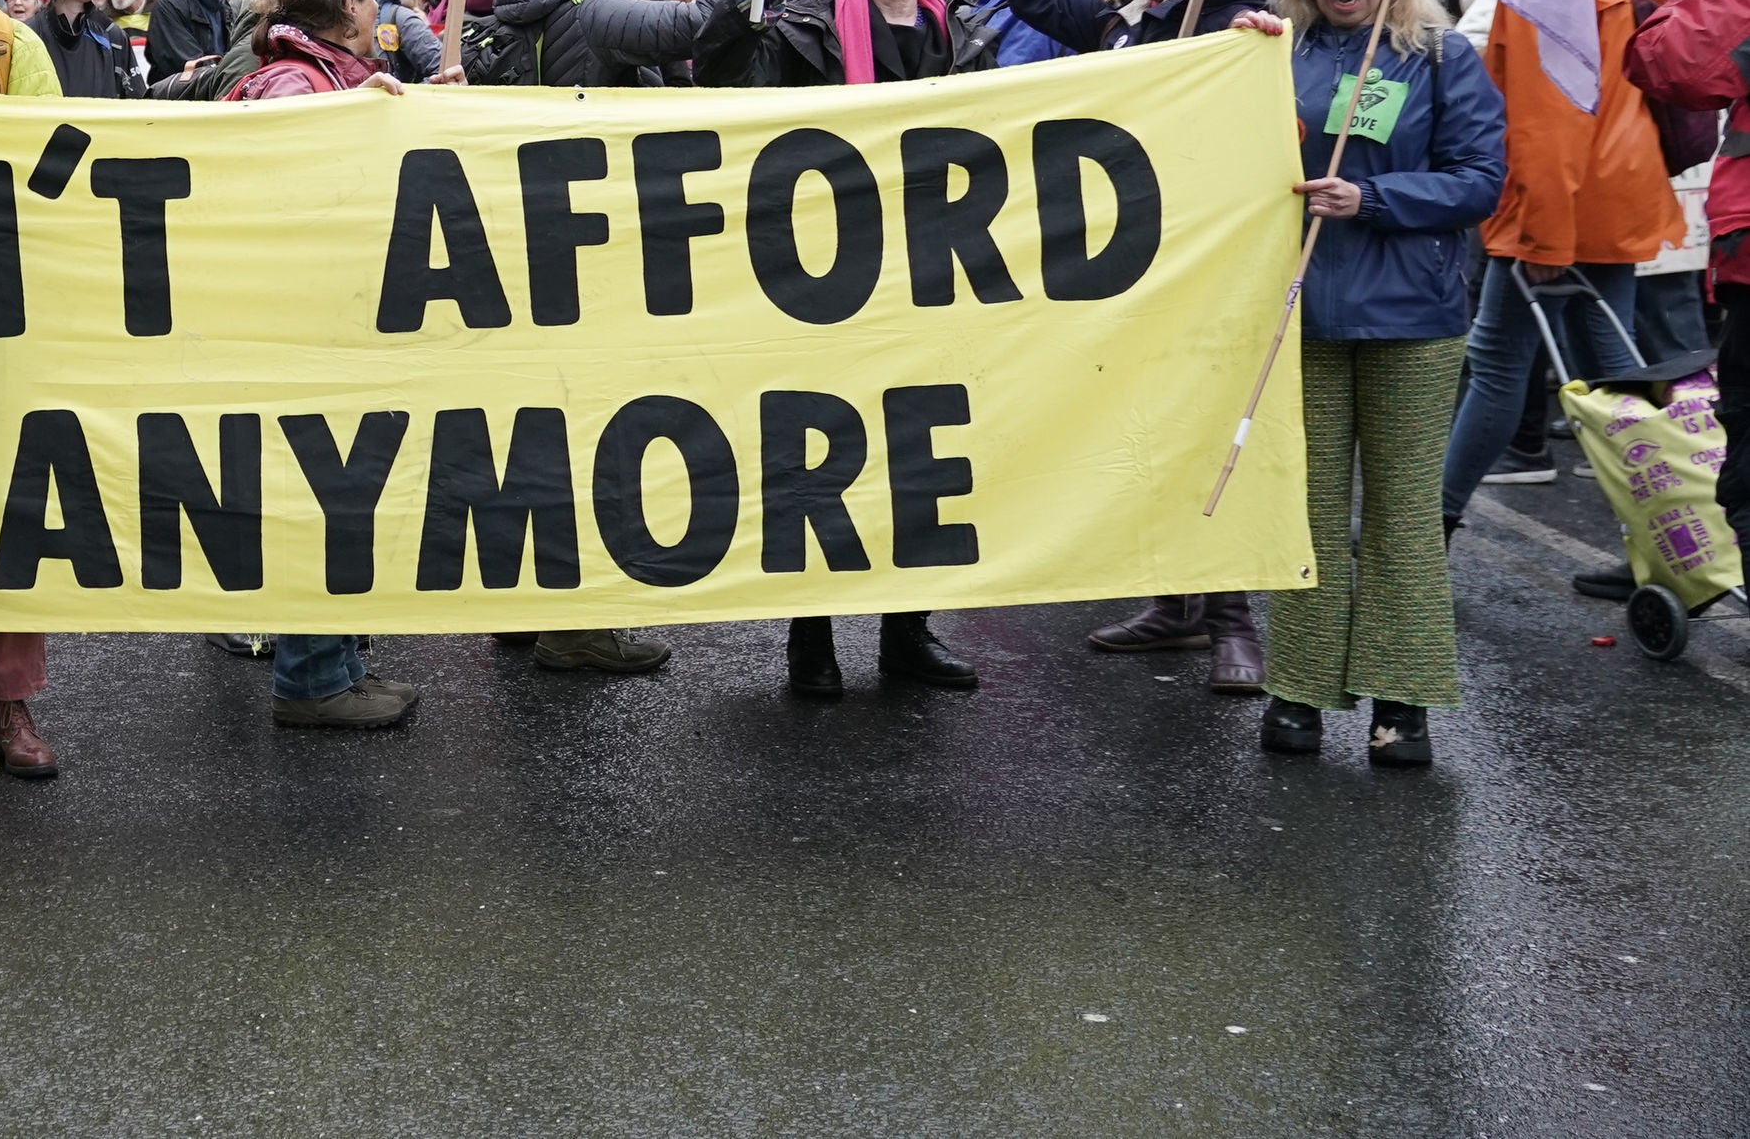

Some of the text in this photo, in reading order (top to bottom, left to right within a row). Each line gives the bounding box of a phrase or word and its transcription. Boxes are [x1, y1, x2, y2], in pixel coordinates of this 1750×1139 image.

[1350, 115, 1378, 131] OVE
[376, 117, 1162, 333] AFFORD
[1682, 414, 1719, 435] IS A
[1691, 446, 1727, 465] CONS
[1647, 461, 1672, 480] ARE
[1651, 475, 1683, 493] 99%
